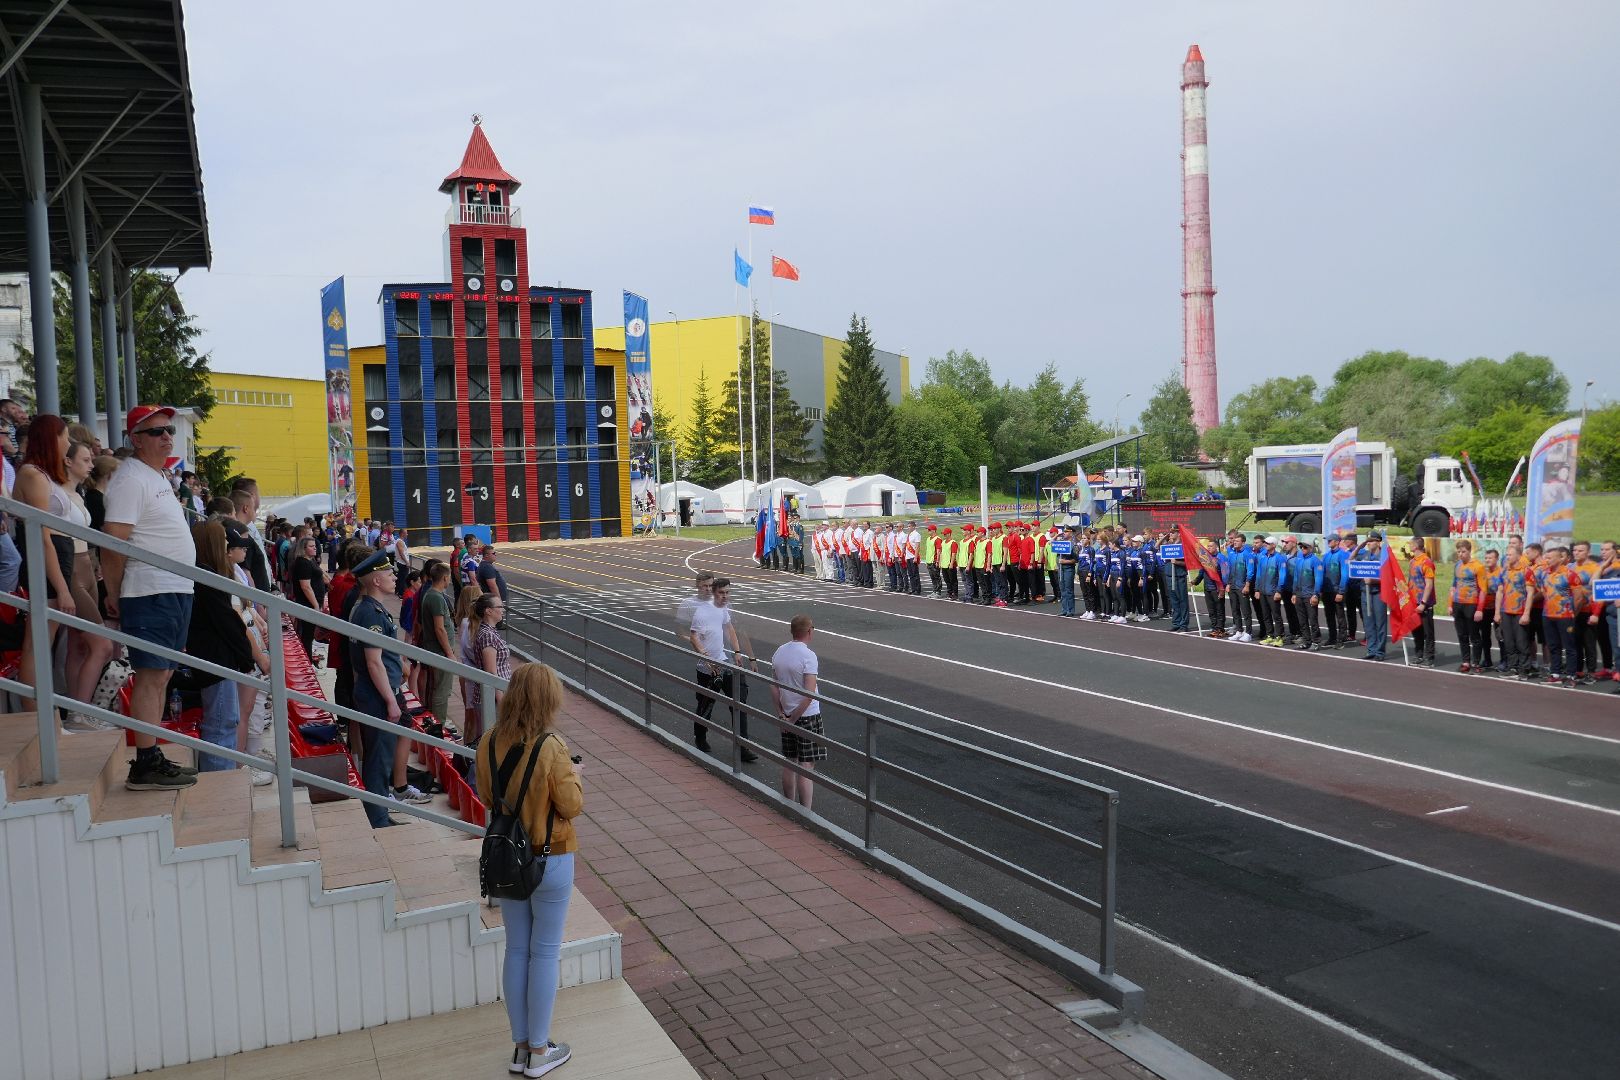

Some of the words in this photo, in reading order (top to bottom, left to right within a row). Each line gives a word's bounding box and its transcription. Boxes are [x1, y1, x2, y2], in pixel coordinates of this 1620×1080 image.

[412, 488, 421, 504] 1
[446, 488, 456, 503] 2
[480, 486, 489, 501] 3
[511, 485, 520, 499] 4
[544, 484, 553, 498] 5
[574, 482, 584, 497] 6
